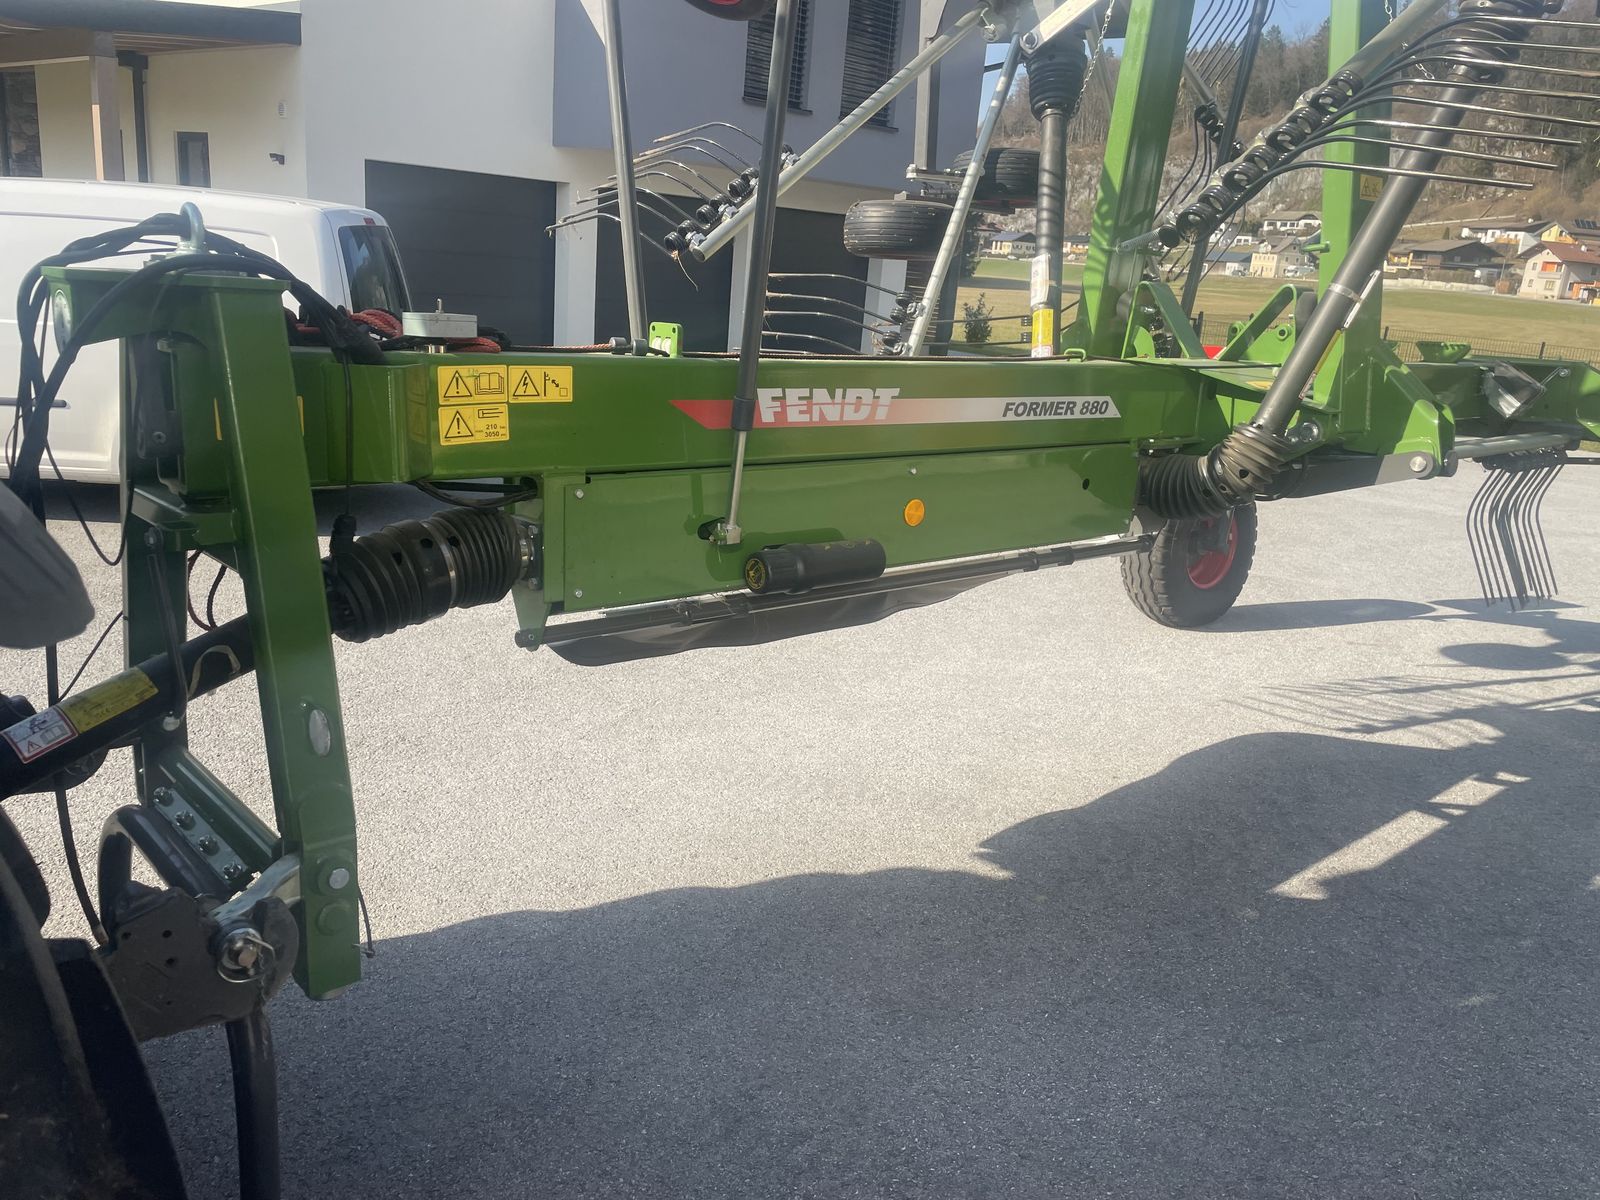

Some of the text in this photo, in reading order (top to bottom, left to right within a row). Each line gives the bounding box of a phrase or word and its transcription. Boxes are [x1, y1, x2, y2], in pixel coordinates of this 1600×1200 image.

[756, 388, 900, 423] FENDT
[1002, 400, 1109, 418] FORMER 880
